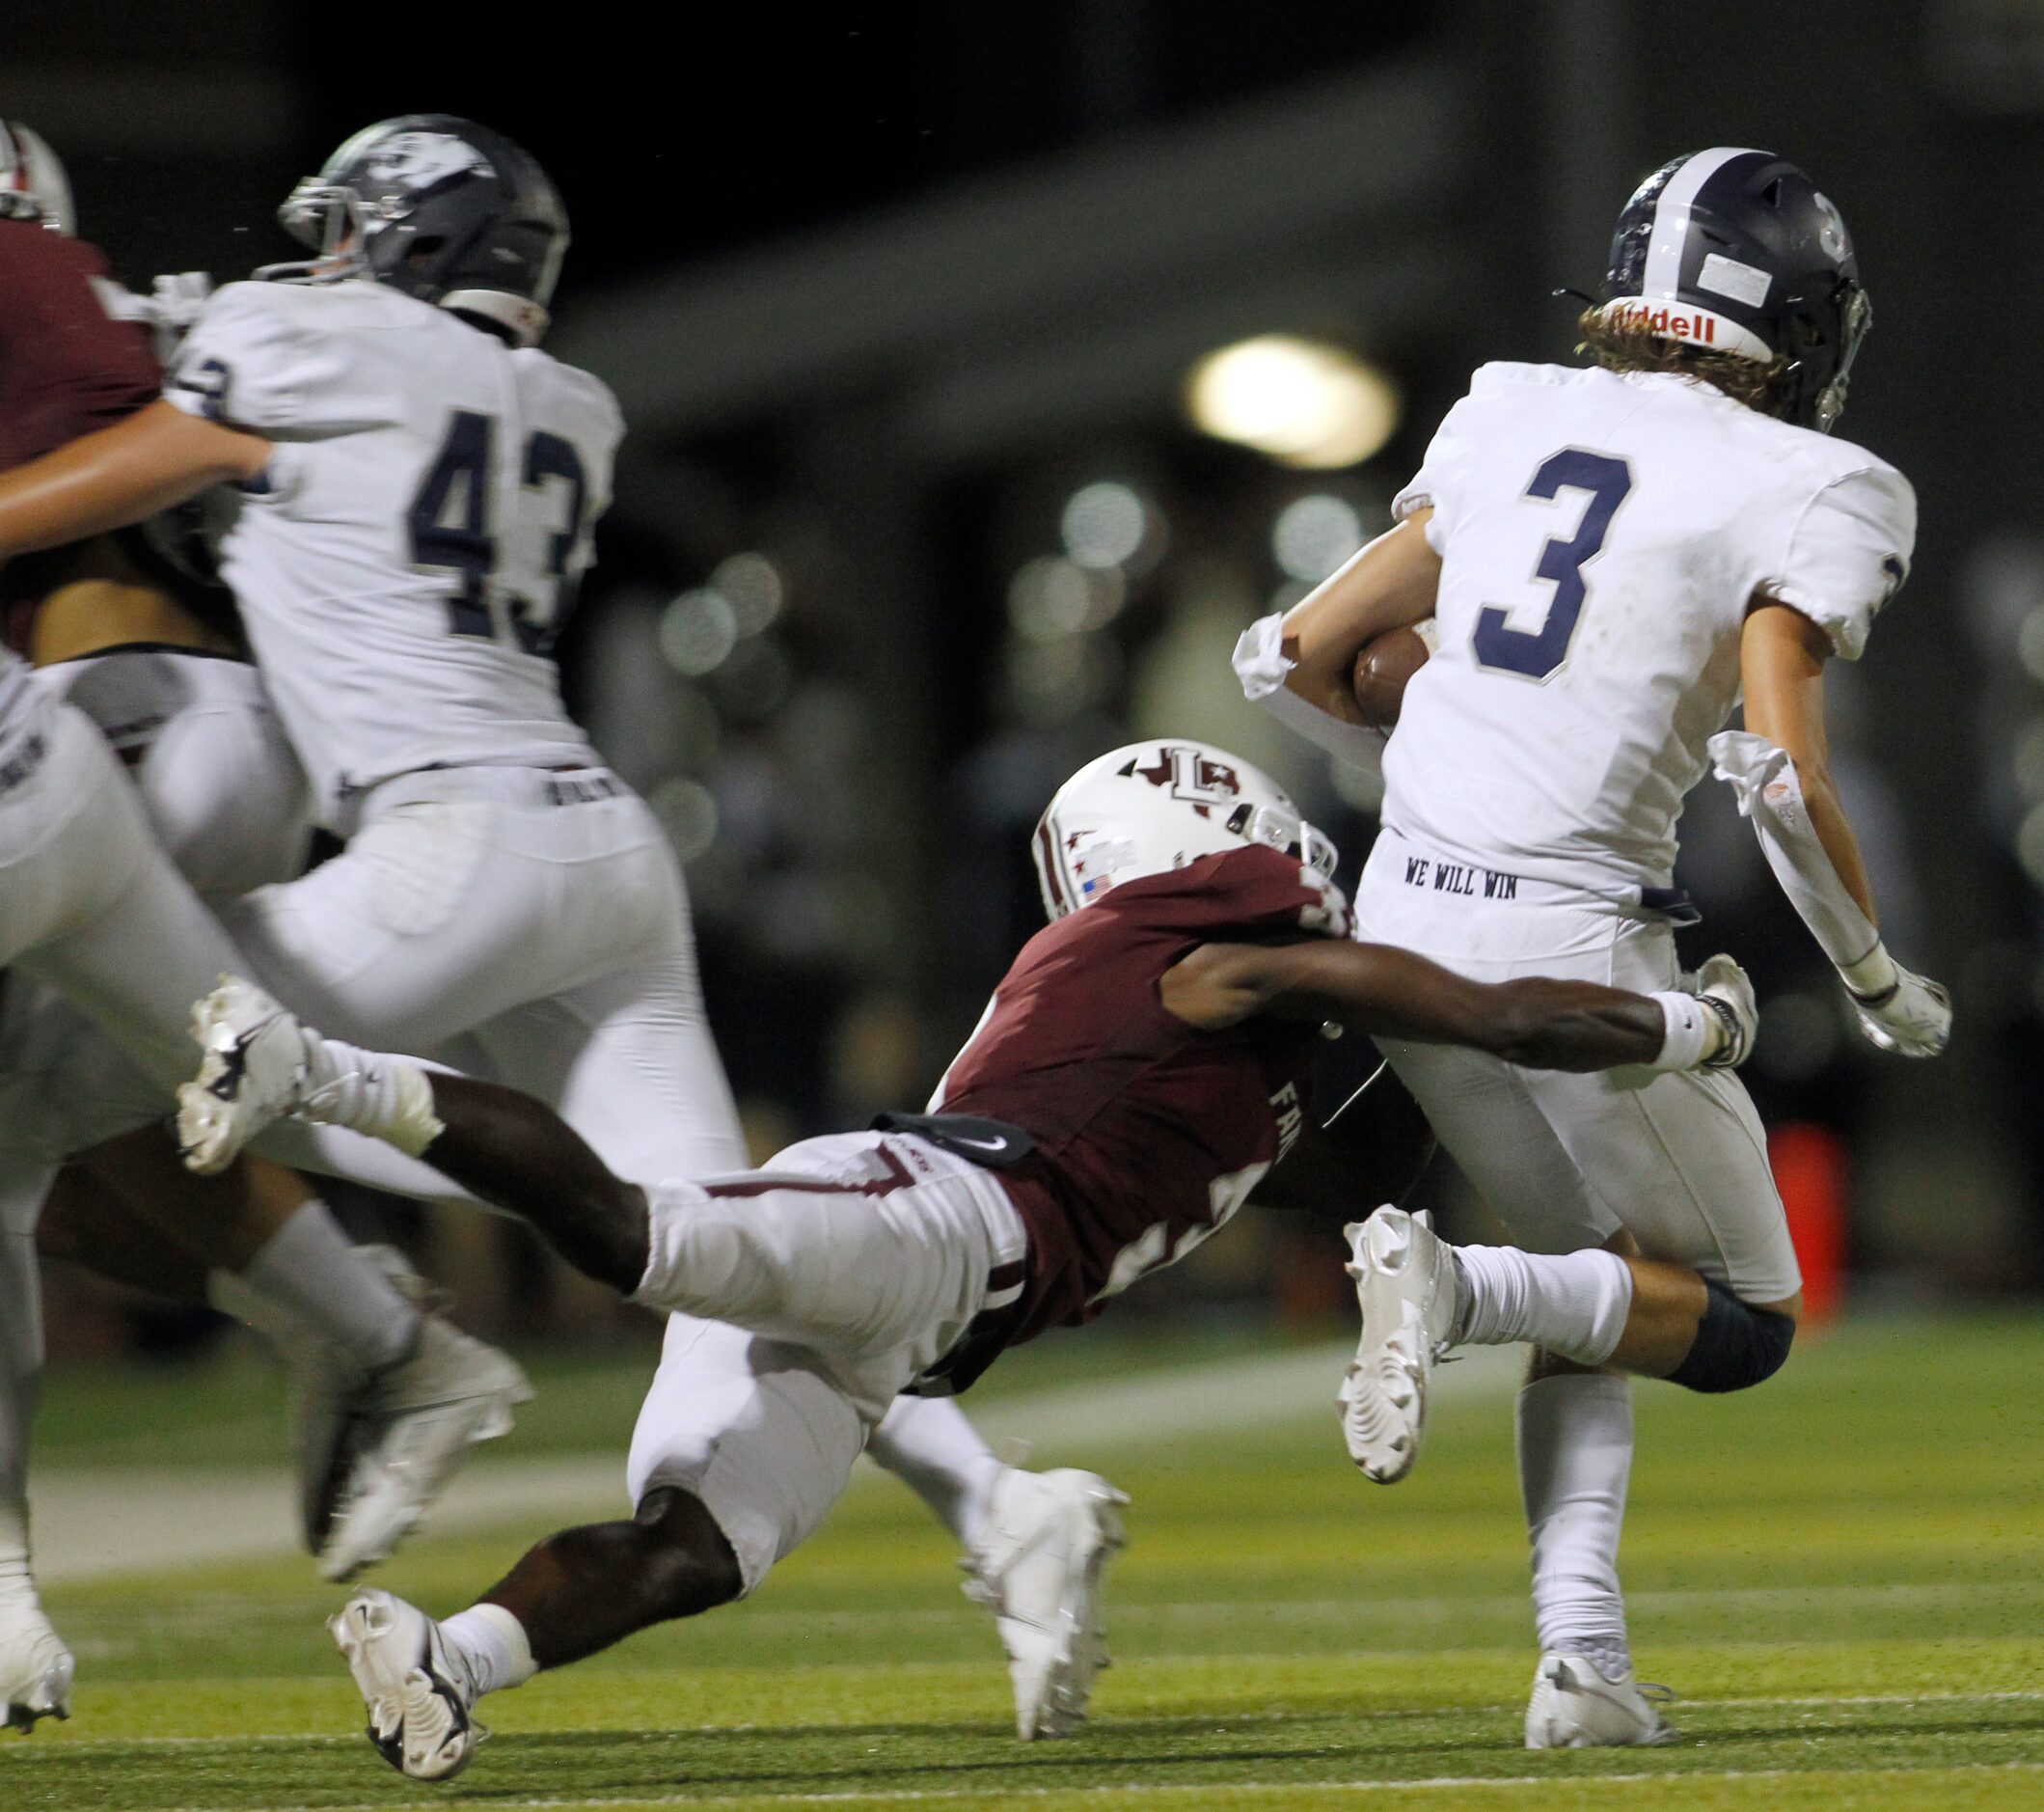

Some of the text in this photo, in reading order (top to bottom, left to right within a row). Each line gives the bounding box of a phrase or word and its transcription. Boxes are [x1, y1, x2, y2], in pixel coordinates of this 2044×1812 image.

[406, 409, 586, 656] 43
[1468, 444, 1638, 686] 3
[1170, 748, 1234, 804] L
[1405, 857, 1518, 899] WE WILL WIN
